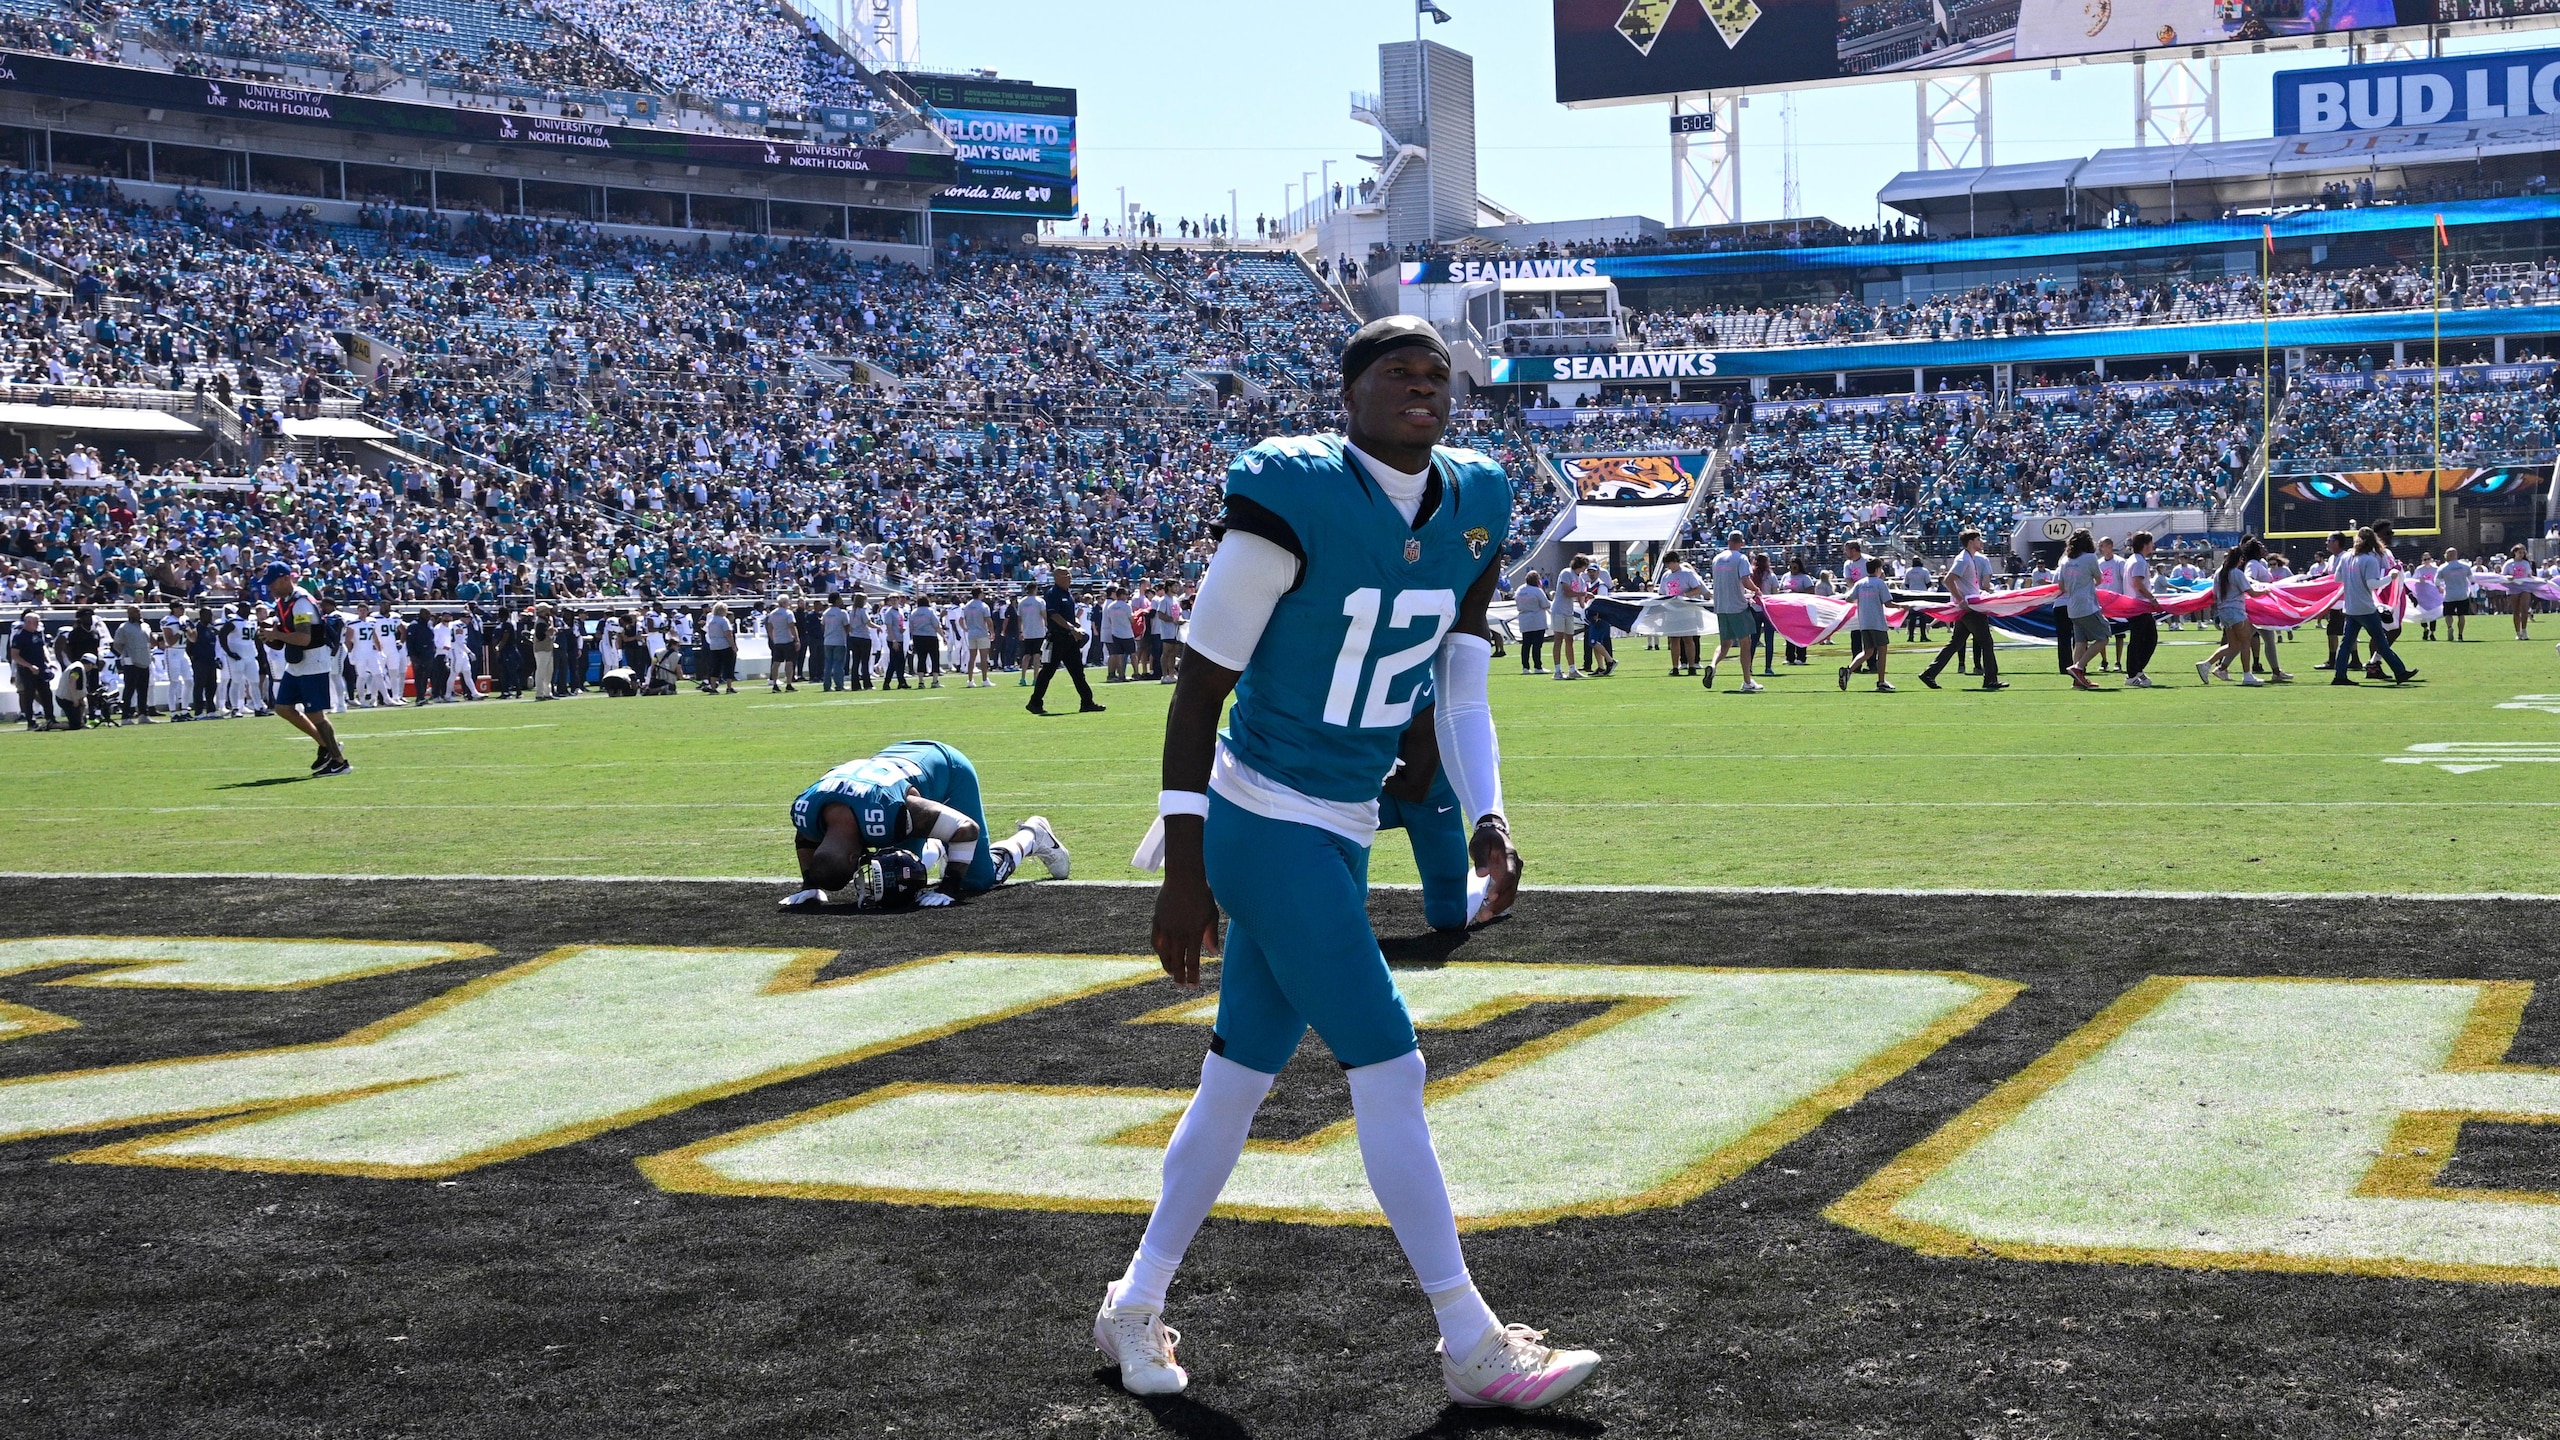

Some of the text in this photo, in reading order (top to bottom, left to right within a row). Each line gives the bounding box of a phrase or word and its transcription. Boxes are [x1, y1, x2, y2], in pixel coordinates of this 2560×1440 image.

[207, 95, 228, 106] UNF
[245, 85, 322, 105] UNIVERSITY of
[239, 98, 330, 118] NORTH FLORIDA
[2298, 73, 2454, 134] BUD
[534, 118, 604, 136] UNIVERSITY of
[1682, 115, 1711, 131] 6:02
[500, 128, 519, 139] UNF
[528, 131, 610, 148] NORTH FLORIDA
[1031, 124, 1058, 146] TO
[764, 155, 782, 165] UNF
[795, 145, 863, 160] UNIVERSITY of
[1002, 147, 1040, 162] GAME
[790, 156, 869, 171] NORTH FLORIDA
[972, 168, 1004, 176] PRESENTED
[991, 186, 1022, 200] Blue
[1448, 258, 1597, 283] SEAHAWKS
[1553, 353, 1717, 380] SEAHAWKS
[2048, 523, 2067, 535] 147
[242, 628, 256, 640] 90
[359, 627, 374, 641] 57
[381, 624, 397, 637] 94
[1322, 587, 1457, 729] 12
[480, 681, 488, 692] G
[794, 799, 810, 828] 65
[864, 808, 886, 837] 65
